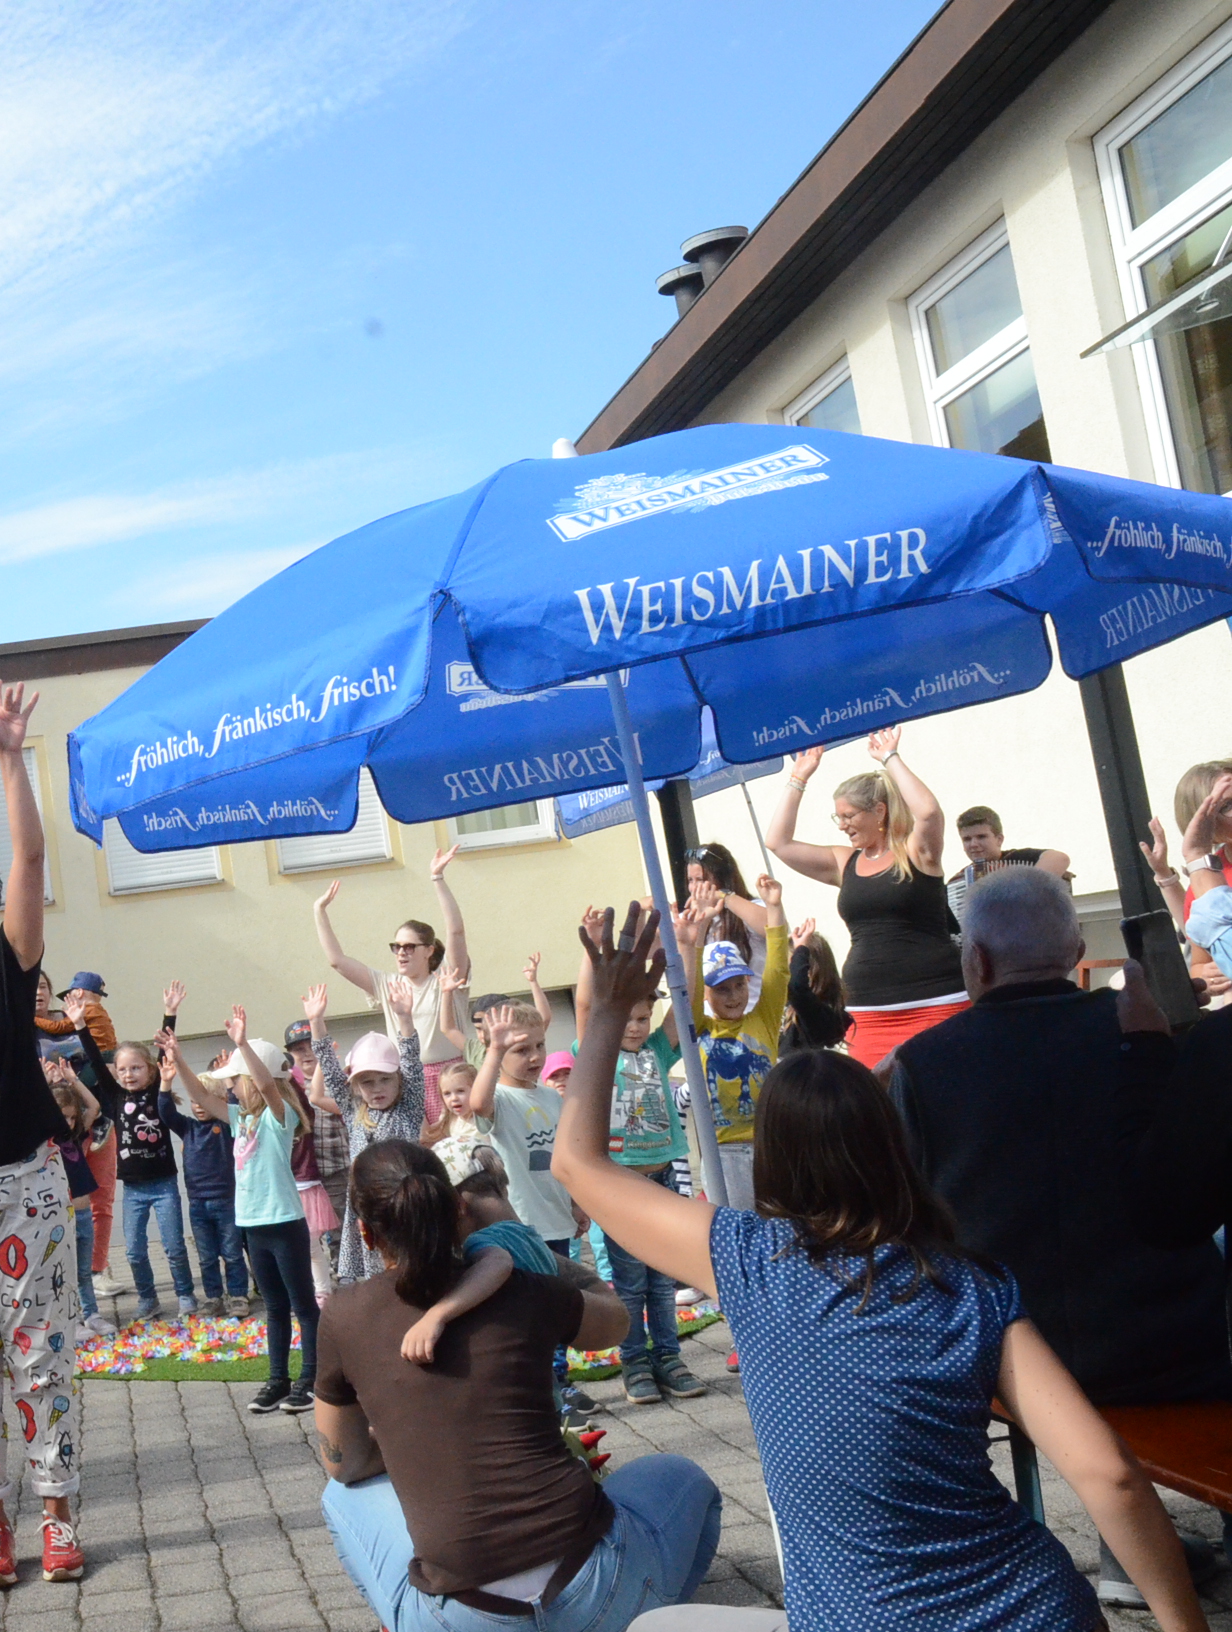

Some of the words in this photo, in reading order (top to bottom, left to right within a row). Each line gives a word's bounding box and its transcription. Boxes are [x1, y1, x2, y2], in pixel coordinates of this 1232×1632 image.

[565, 452, 809, 529] WEISMAINER
[1087, 515, 1166, 558] ...fröhlich,
[1165, 522, 1228, 564] fränkisch,
[572, 526, 932, 646] WEISMAINER
[116, 729, 204, 788] ...fröhlich,
[205, 693, 311, 759] fränkisch,
[310, 664, 398, 724] frisch!
